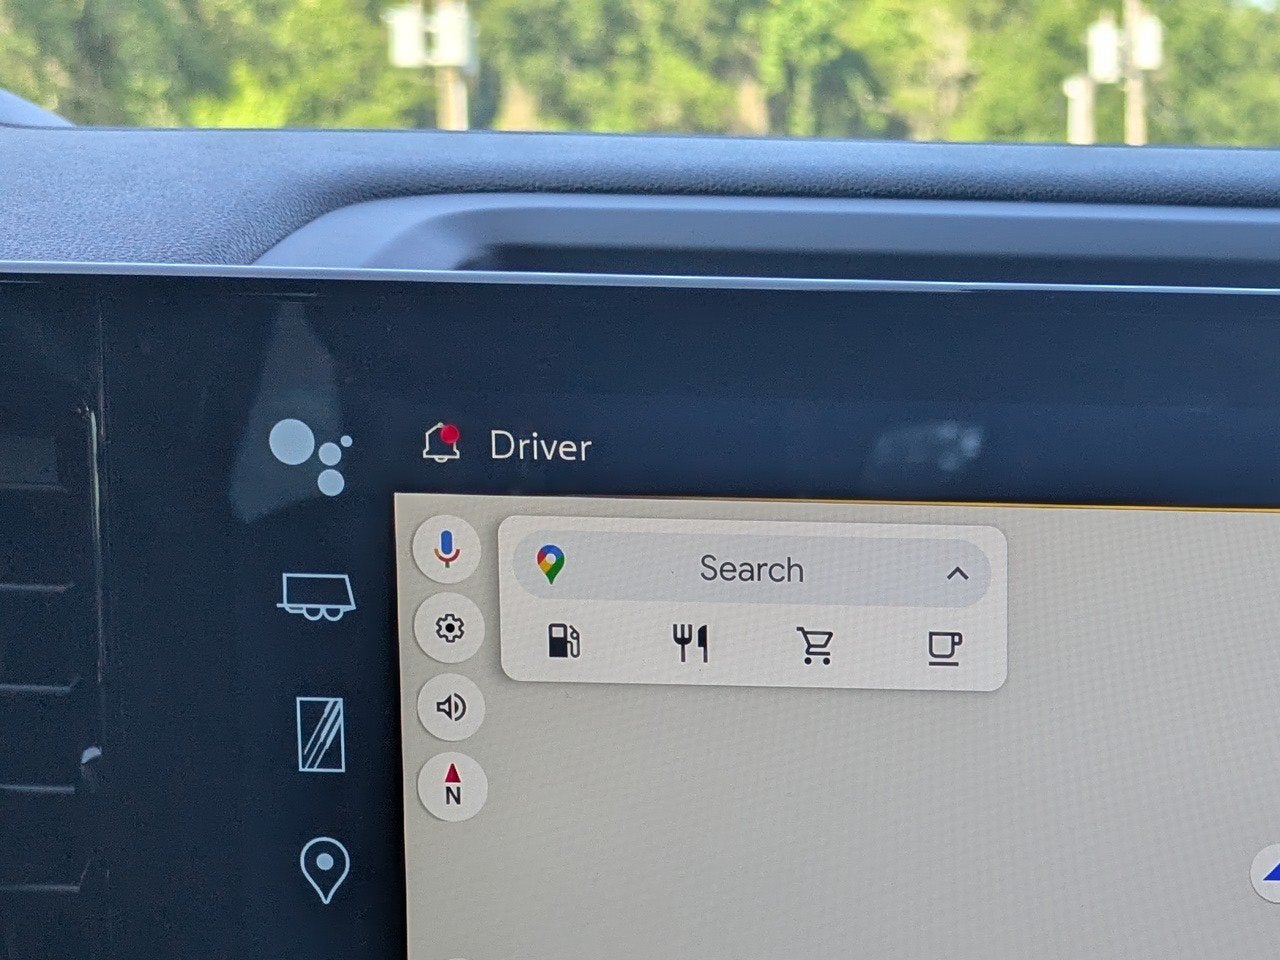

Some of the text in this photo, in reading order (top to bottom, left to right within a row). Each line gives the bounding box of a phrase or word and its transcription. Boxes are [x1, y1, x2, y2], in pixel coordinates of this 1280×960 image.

[491, 429, 593, 461] Driver
[700, 554, 804, 583] Search
[445, 786, 462, 806] N
